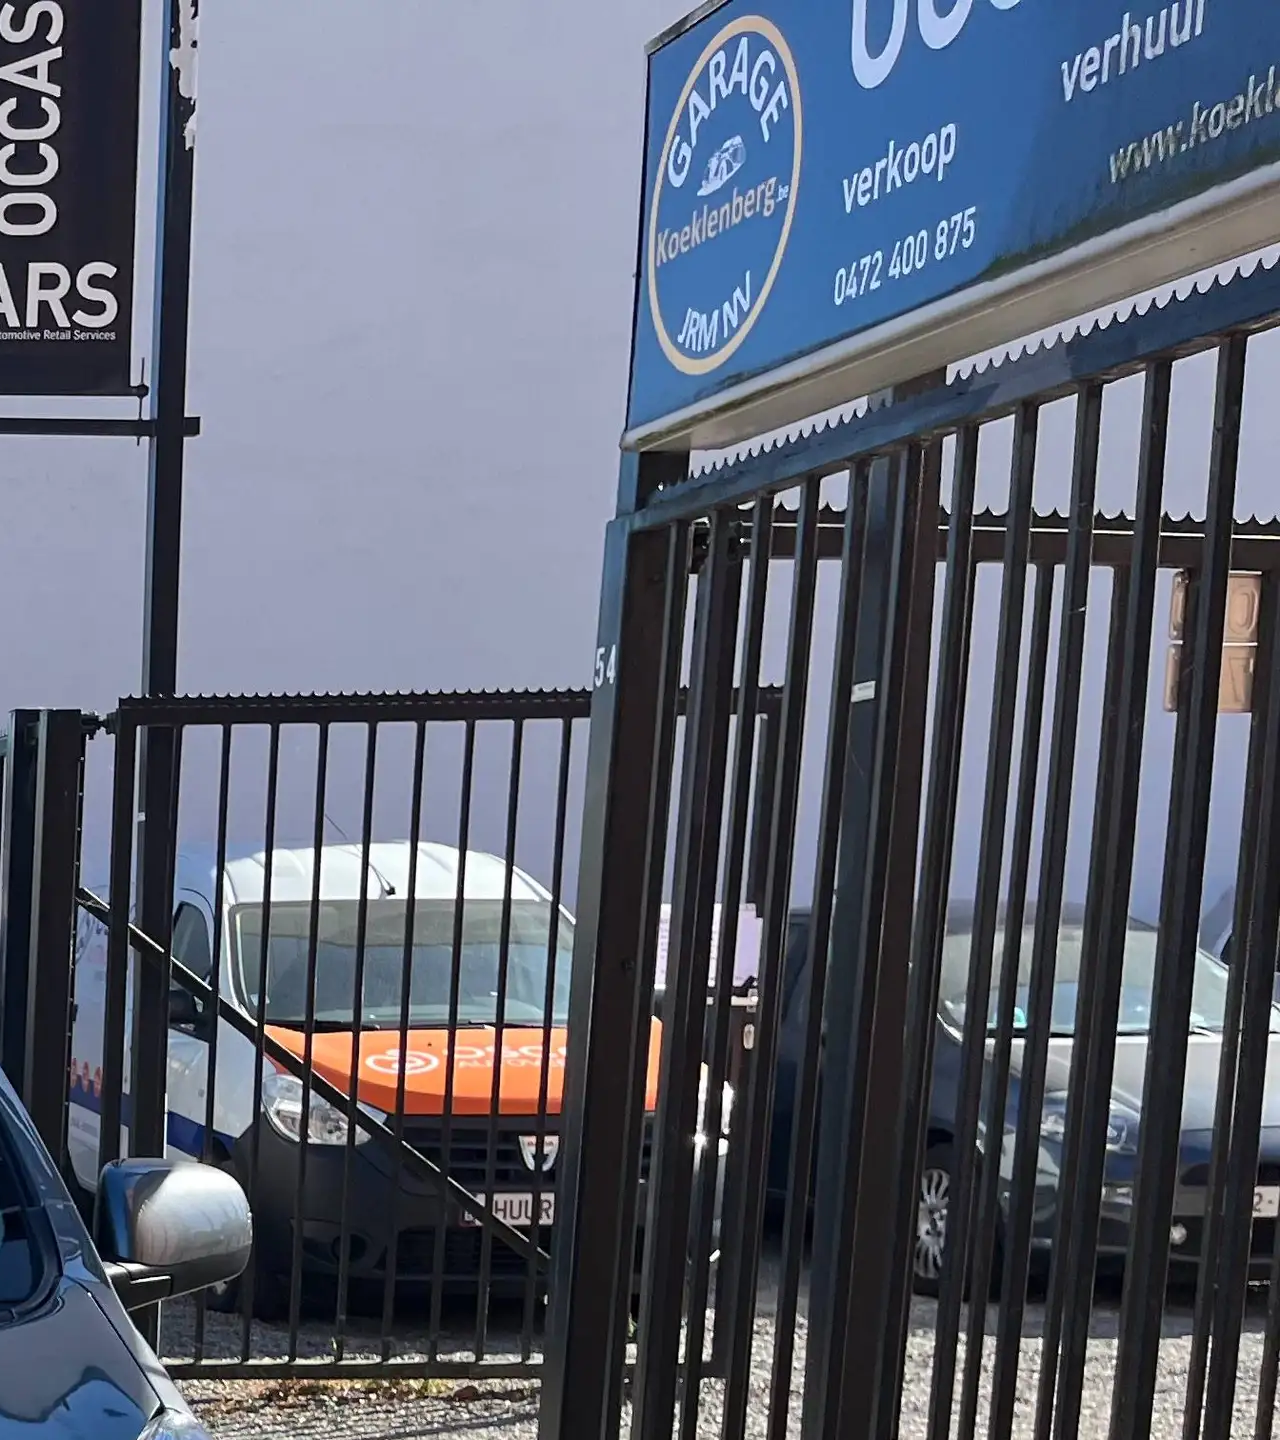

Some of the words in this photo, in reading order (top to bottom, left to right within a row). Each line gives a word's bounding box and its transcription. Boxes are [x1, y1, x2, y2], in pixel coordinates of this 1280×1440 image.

[667, 37, 789, 188] GARAGE
[842, 122, 957, 214] verkoop
[833, 250, 883, 306] 0472
[887, 229, 929, 280] 400
[934, 205, 977, 261] 875
[43, 329, 72, 341] Retail
[72, 329, 117, 341] Services
[677, 307, 720, 353] JRM
[594, 644, 617, 688] 54
